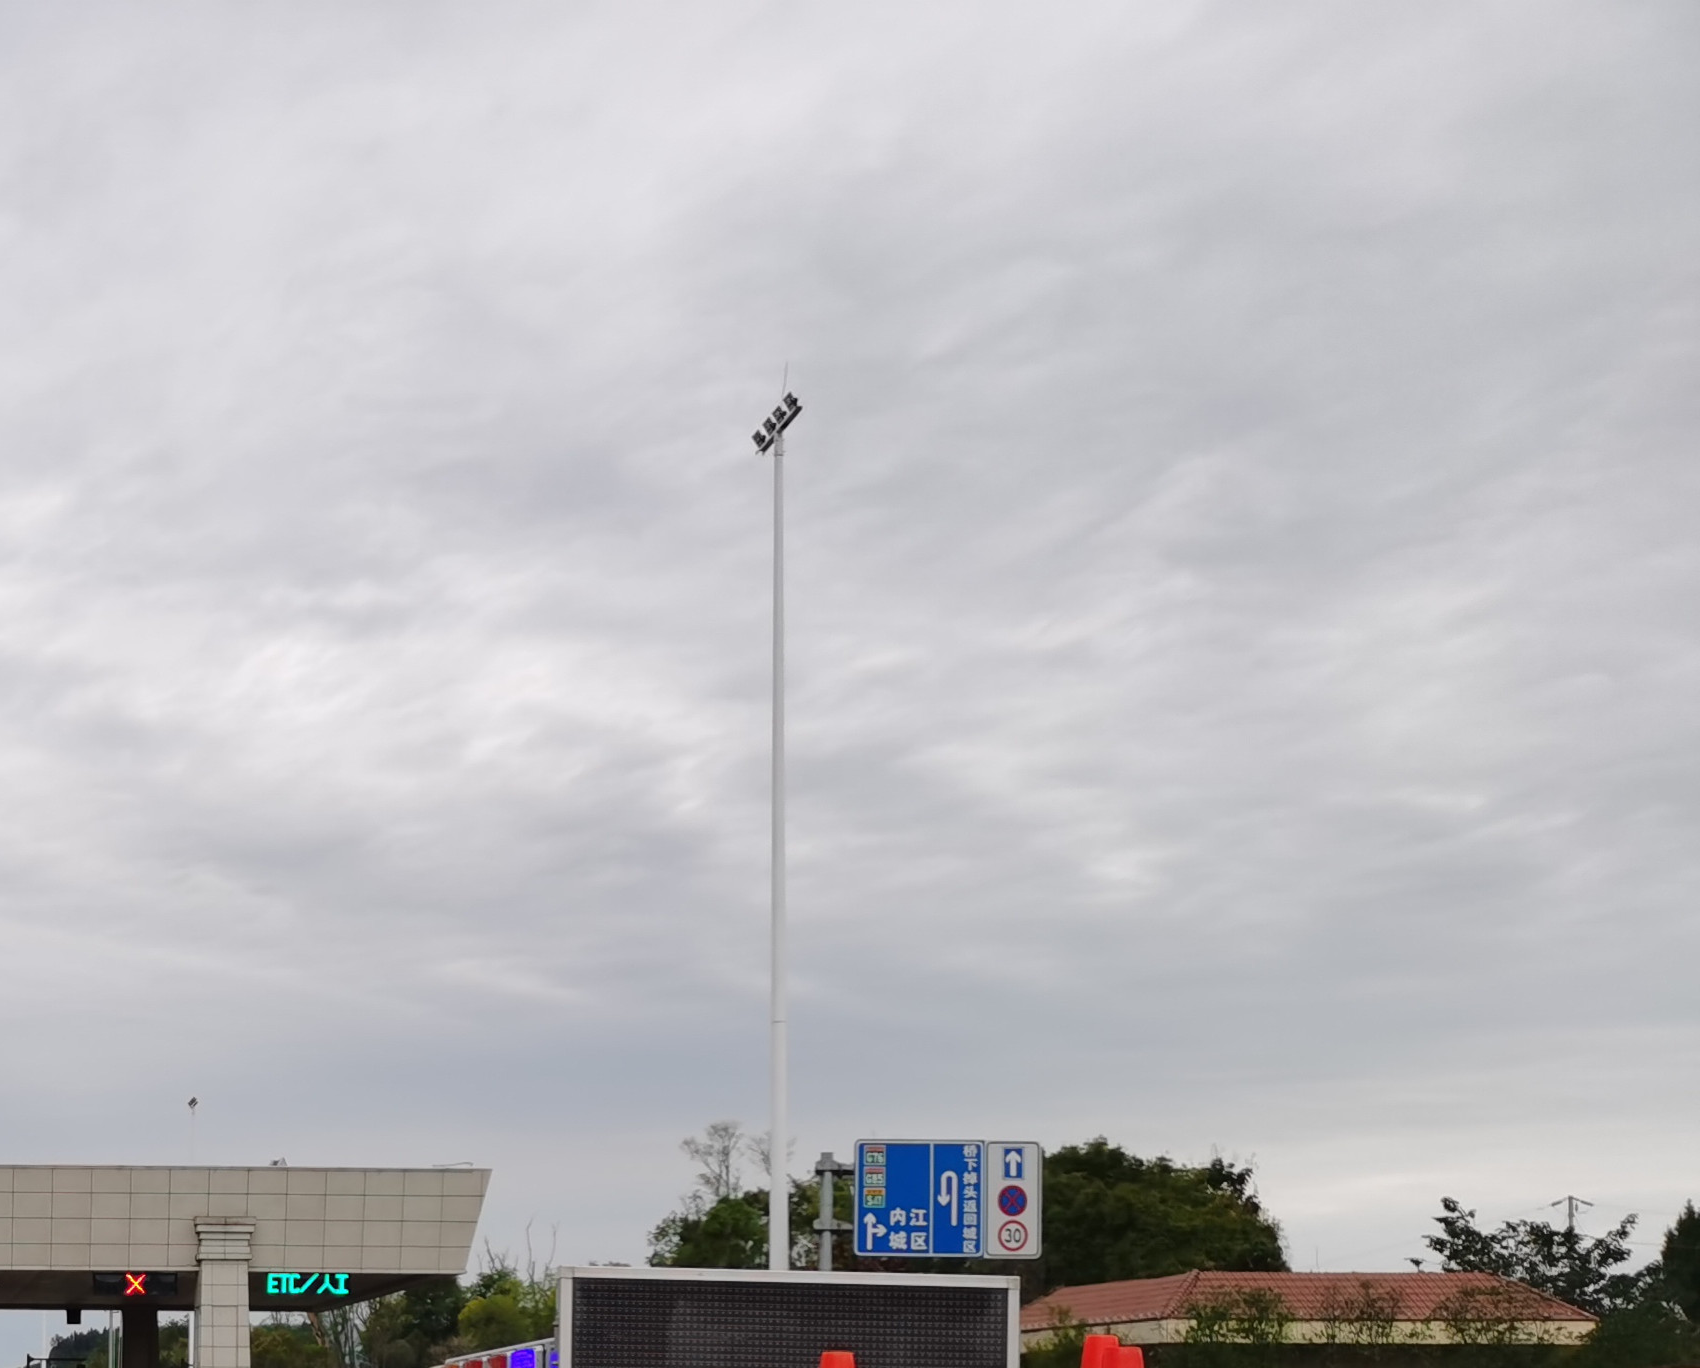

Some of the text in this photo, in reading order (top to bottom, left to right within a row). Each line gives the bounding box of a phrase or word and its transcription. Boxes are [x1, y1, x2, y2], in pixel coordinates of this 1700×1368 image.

[889, 1207, 928, 1227] 内江
[888, 1231, 928, 1251] 城区
[1004, 1228, 1022, 1244] 30
[266, 1272, 350, 1295] ETC/人工
